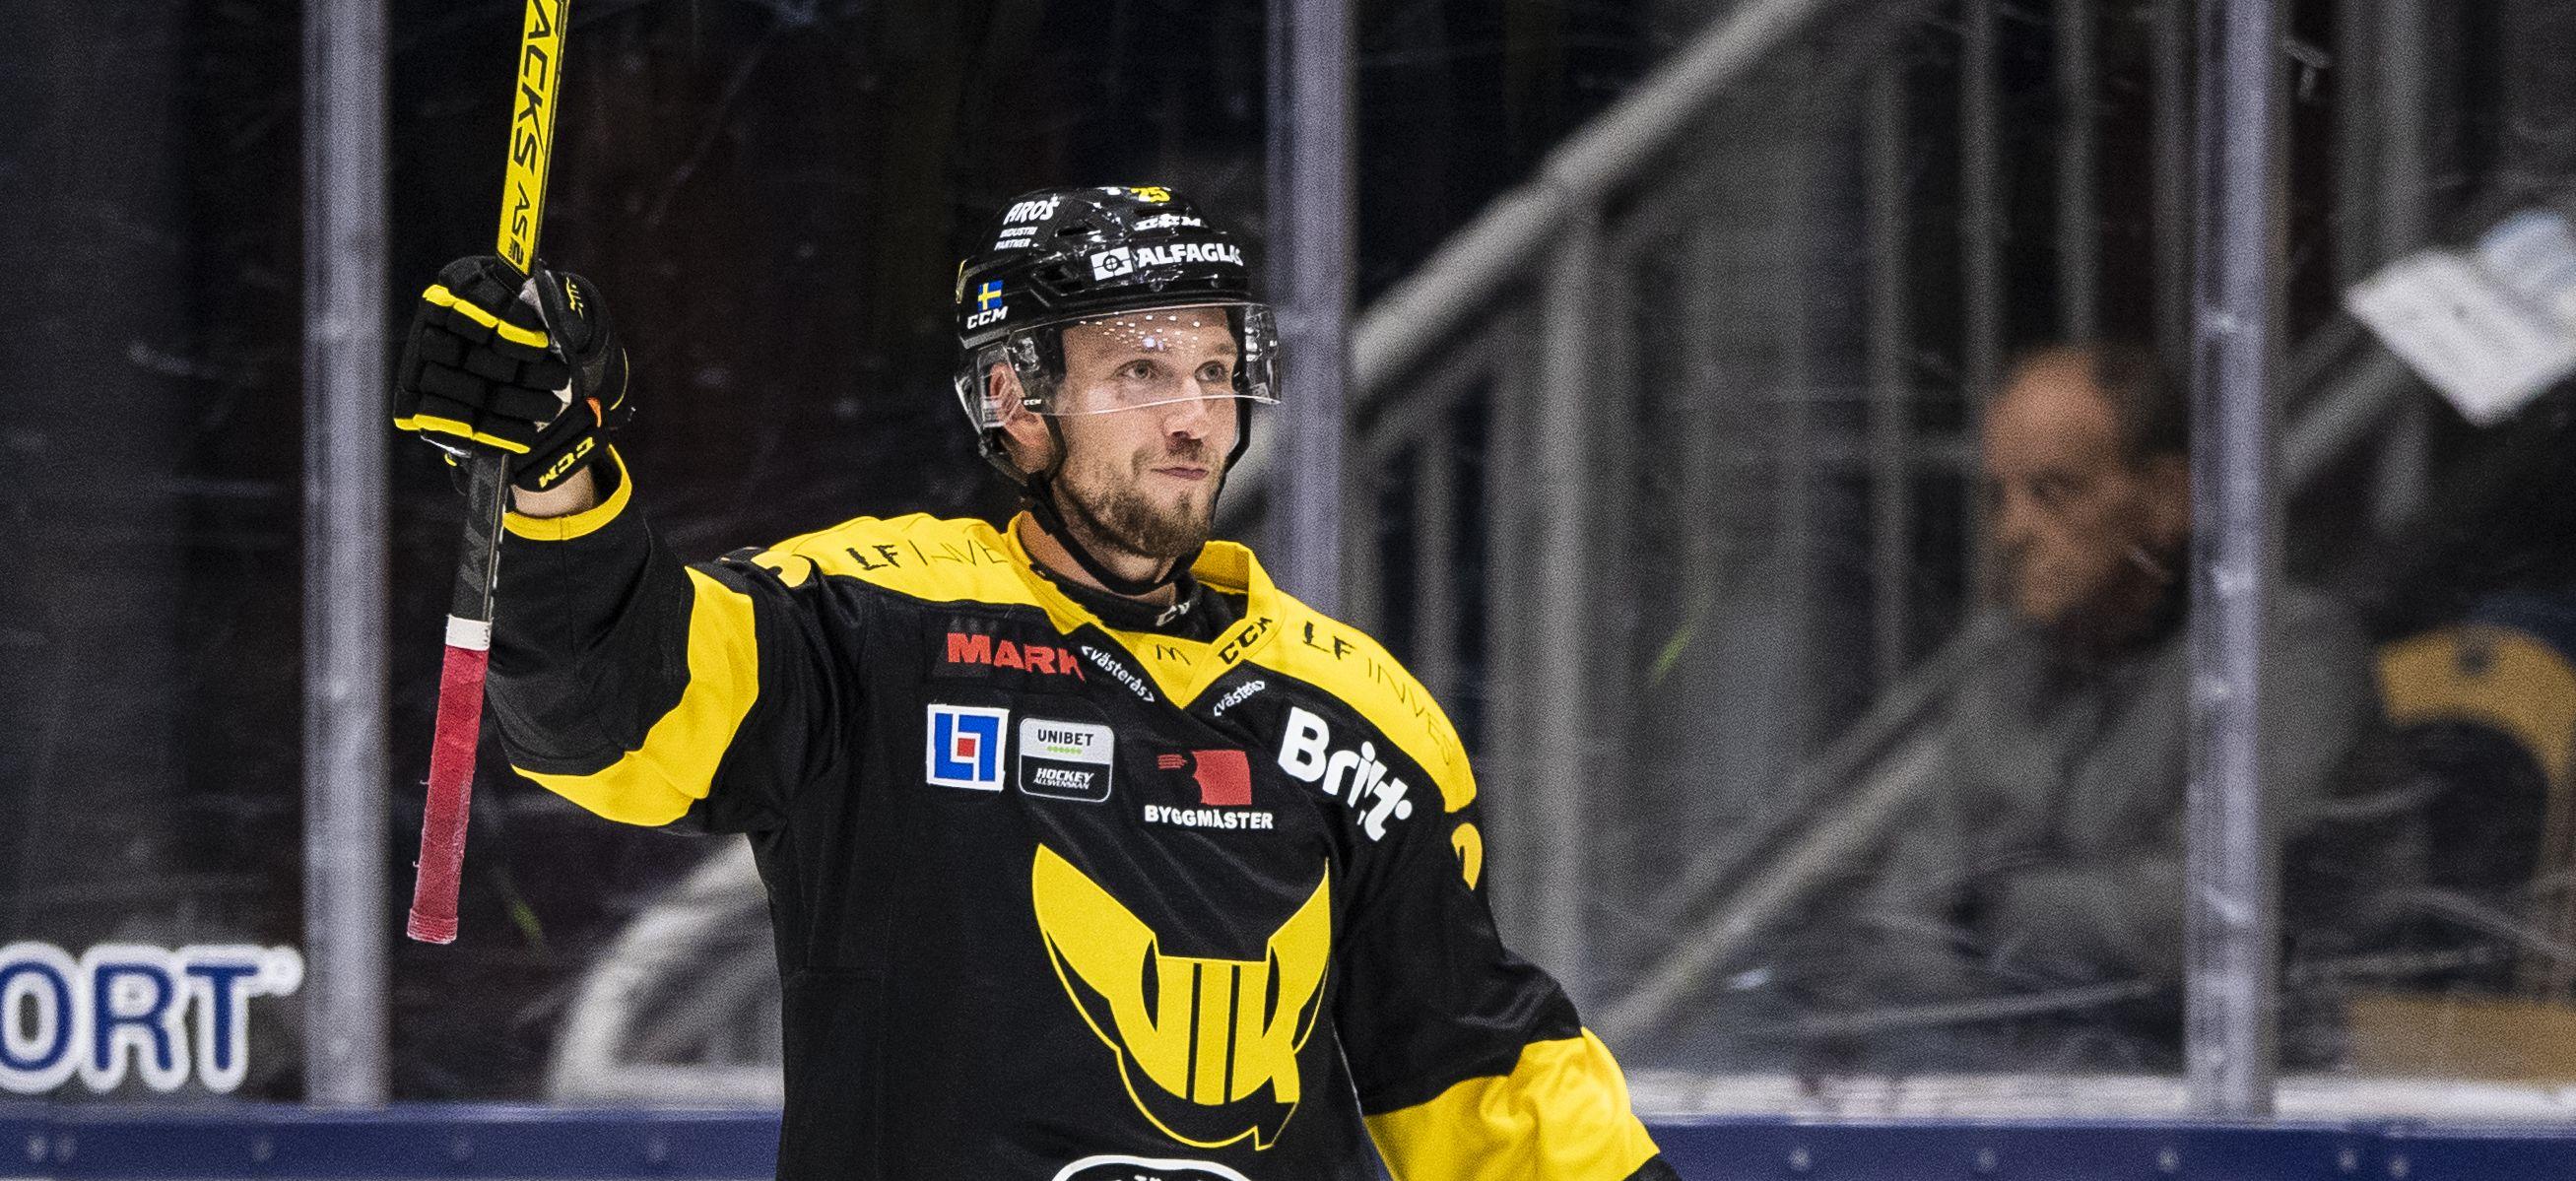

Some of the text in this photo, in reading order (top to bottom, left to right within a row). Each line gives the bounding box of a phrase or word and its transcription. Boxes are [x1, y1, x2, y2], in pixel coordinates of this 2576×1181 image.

[966, 305, 1009, 330] CCM
[539, 437, 593, 489] CCM
[845, 544, 900, 571] LF
[1218, 617, 1274, 665] CCM
[1302, 620, 1356, 661] LF
[1037, 728, 1094, 747] UNIBET
[1034, 767, 1095, 784] HOCKEY
[1144, 804, 1274, 829] BYGGMÄSTER
